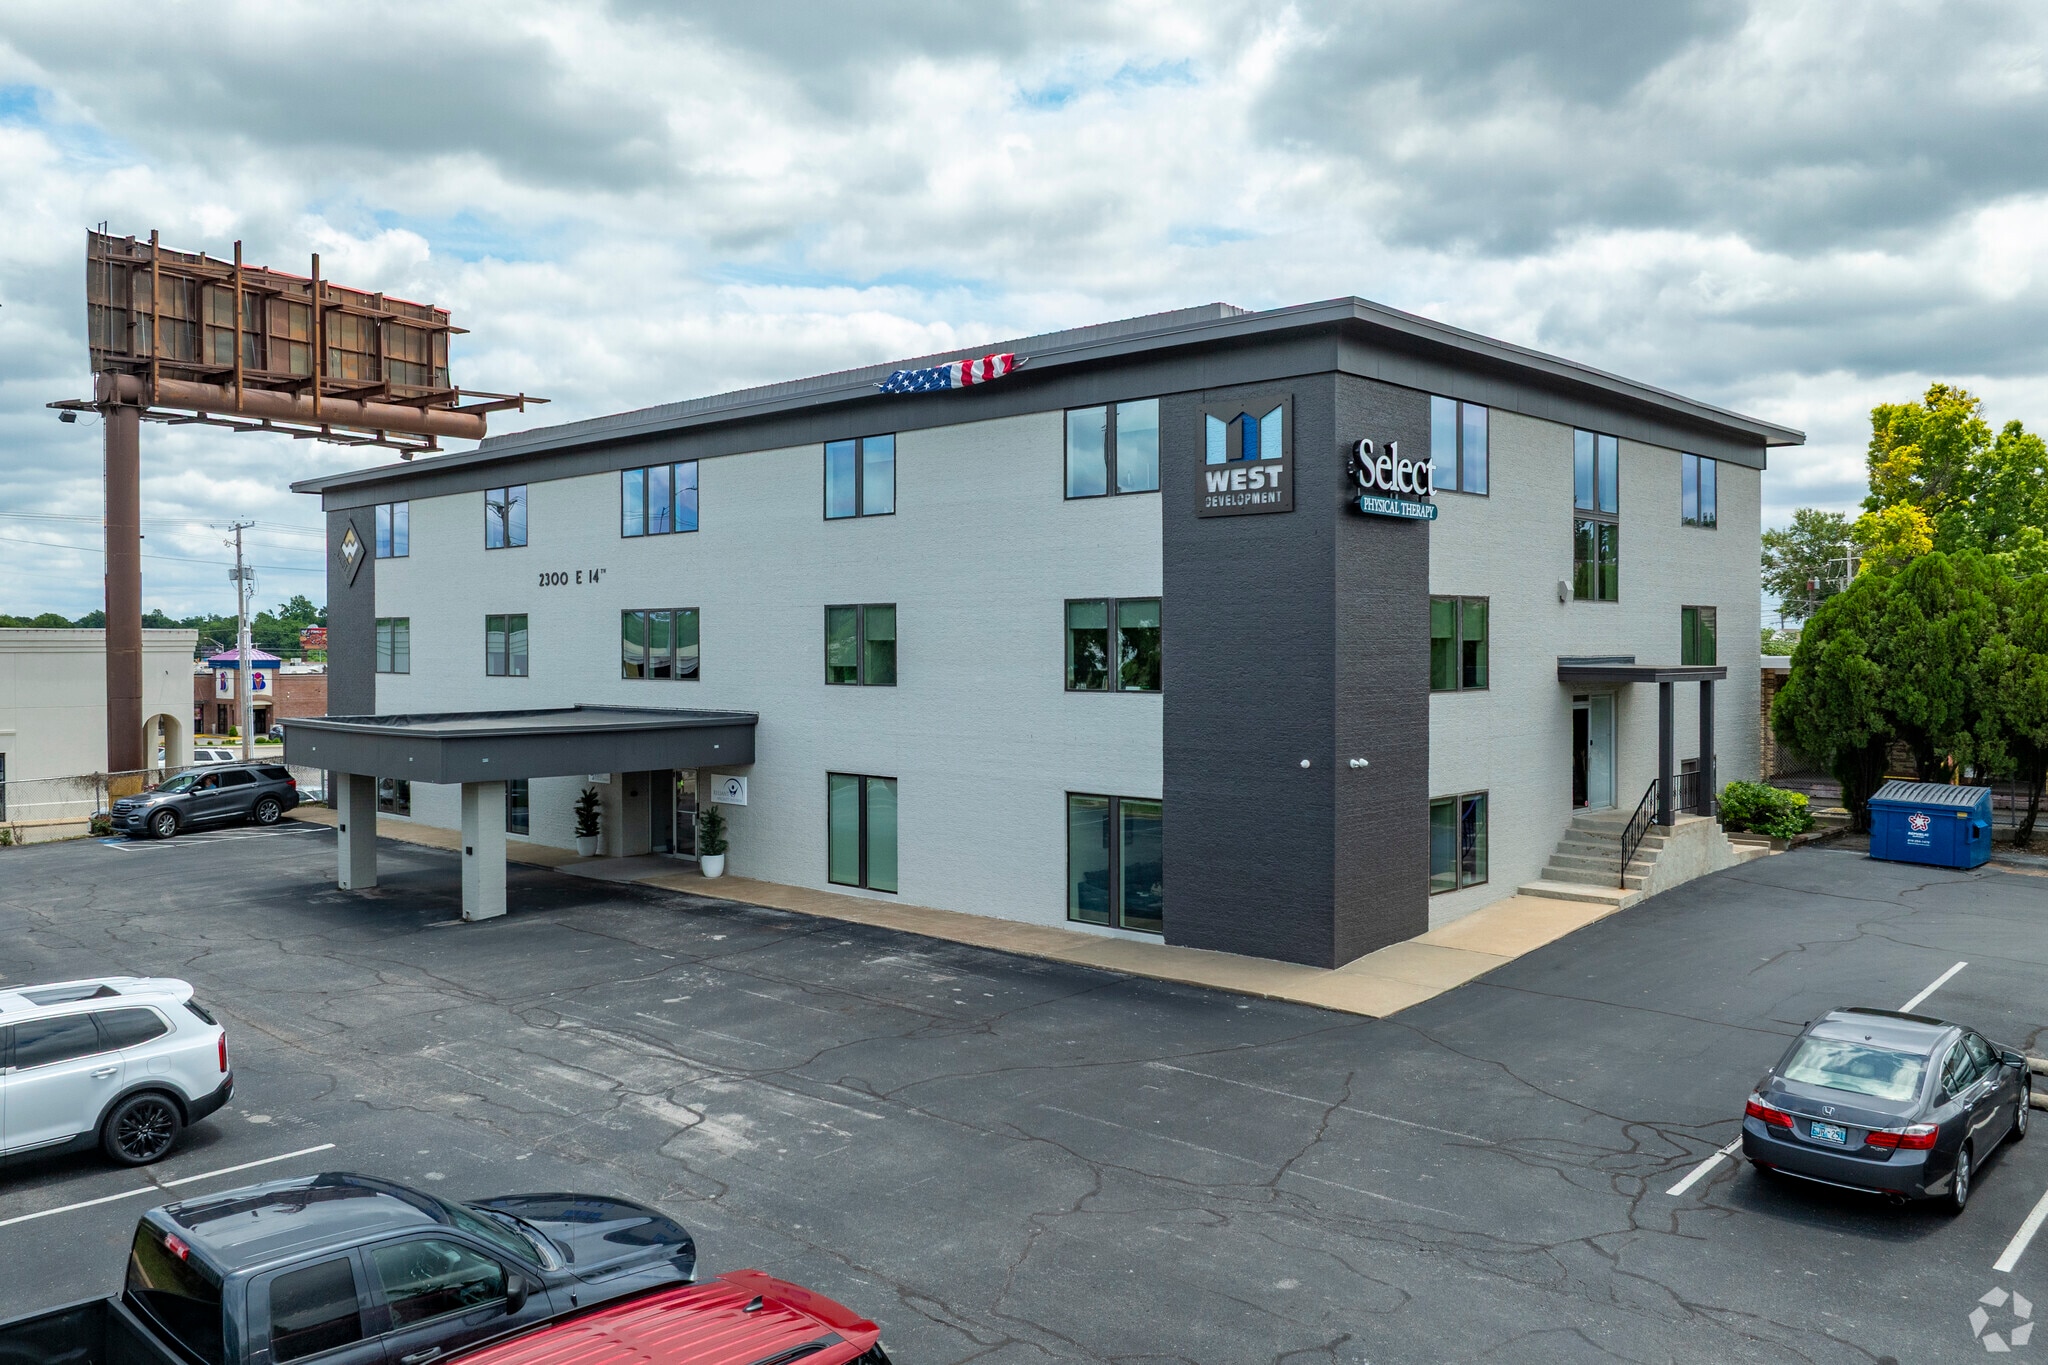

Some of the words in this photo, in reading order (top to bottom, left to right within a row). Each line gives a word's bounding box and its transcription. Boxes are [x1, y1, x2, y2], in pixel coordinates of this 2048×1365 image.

[1359, 438, 1438, 496] Select
[1205, 464, 1283, 493] WEST
[1205, 490, 1282, 508] DEVELOPMENT
[1363, 497, 1400, 515] PHYSICAL
[1401, 501, 1435, 519] THERAPY
[539, 571, 569, 587] 2300
[576, 570, 582, 584] E
